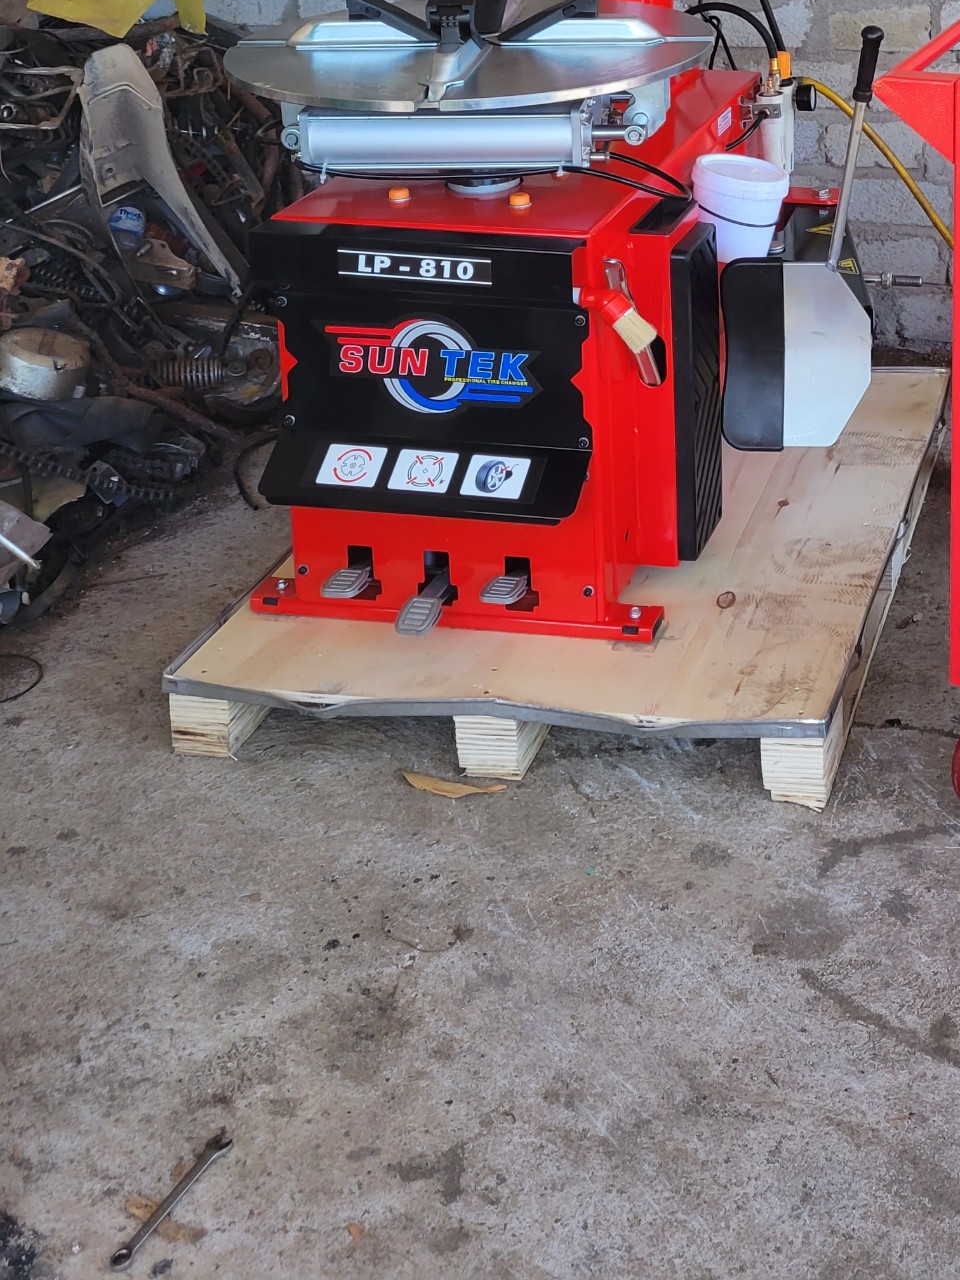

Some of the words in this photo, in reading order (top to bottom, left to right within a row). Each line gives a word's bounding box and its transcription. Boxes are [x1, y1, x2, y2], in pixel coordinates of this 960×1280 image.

[357, 254, 391, 273] LP
[418, 259, 474, 280] 810
[338, 345, 429, 377] SUN
[439, 349, 529, 382] TEK
[443, 376, 485, 384] PROFESSIONAL
[500, 378, 528, 386] CHANGER
